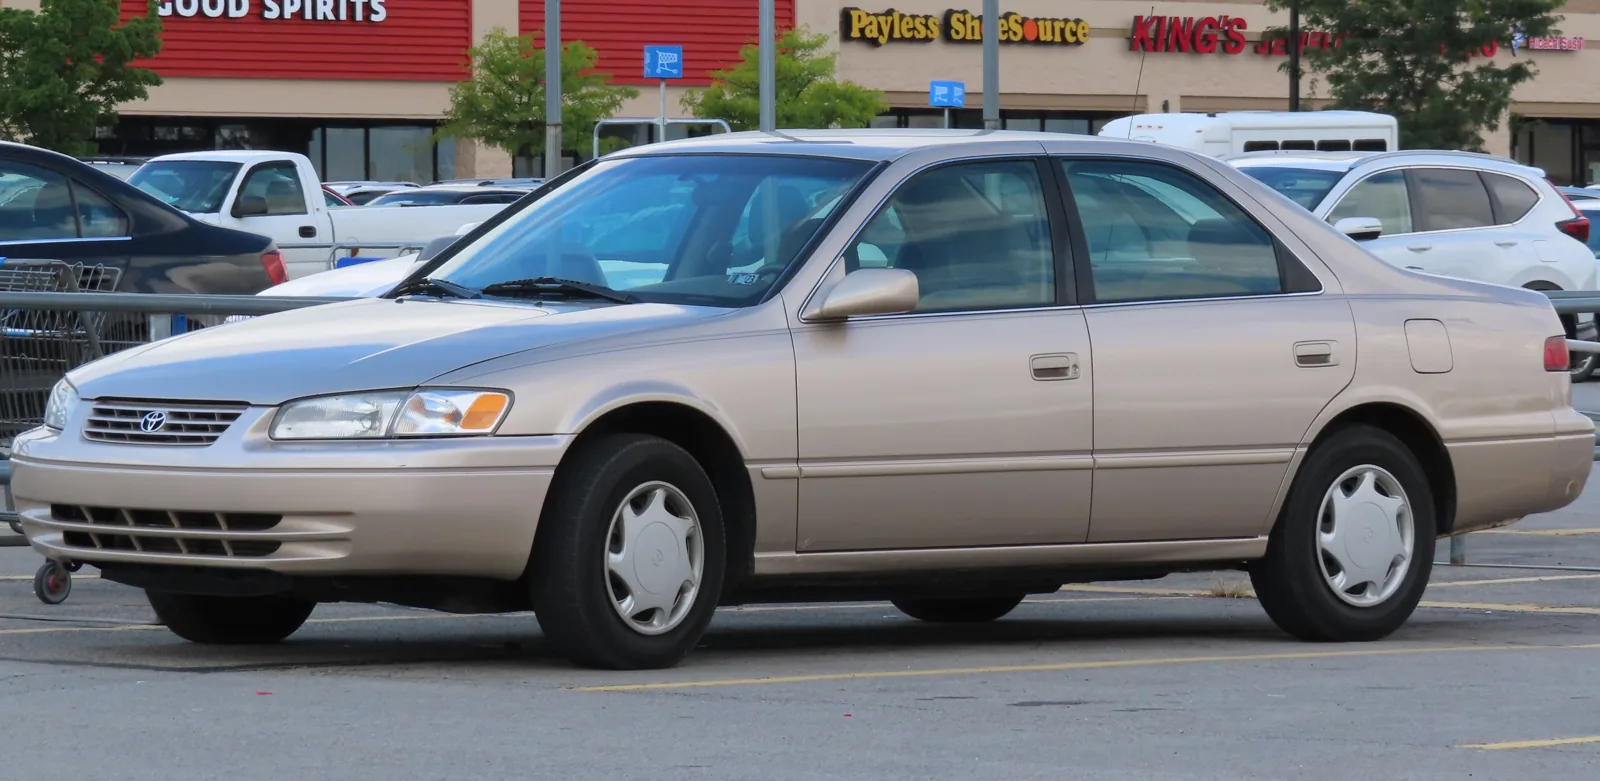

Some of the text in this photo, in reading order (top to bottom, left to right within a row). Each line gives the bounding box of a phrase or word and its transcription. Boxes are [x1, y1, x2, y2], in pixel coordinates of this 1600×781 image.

[263, 0, 388, 22] SPIRITS
[850, 10, 1090, 44] Payless SheSource
[1131, 15, 1248, 55] KING'S
[1561, 36, 1584, 50] Sushi
